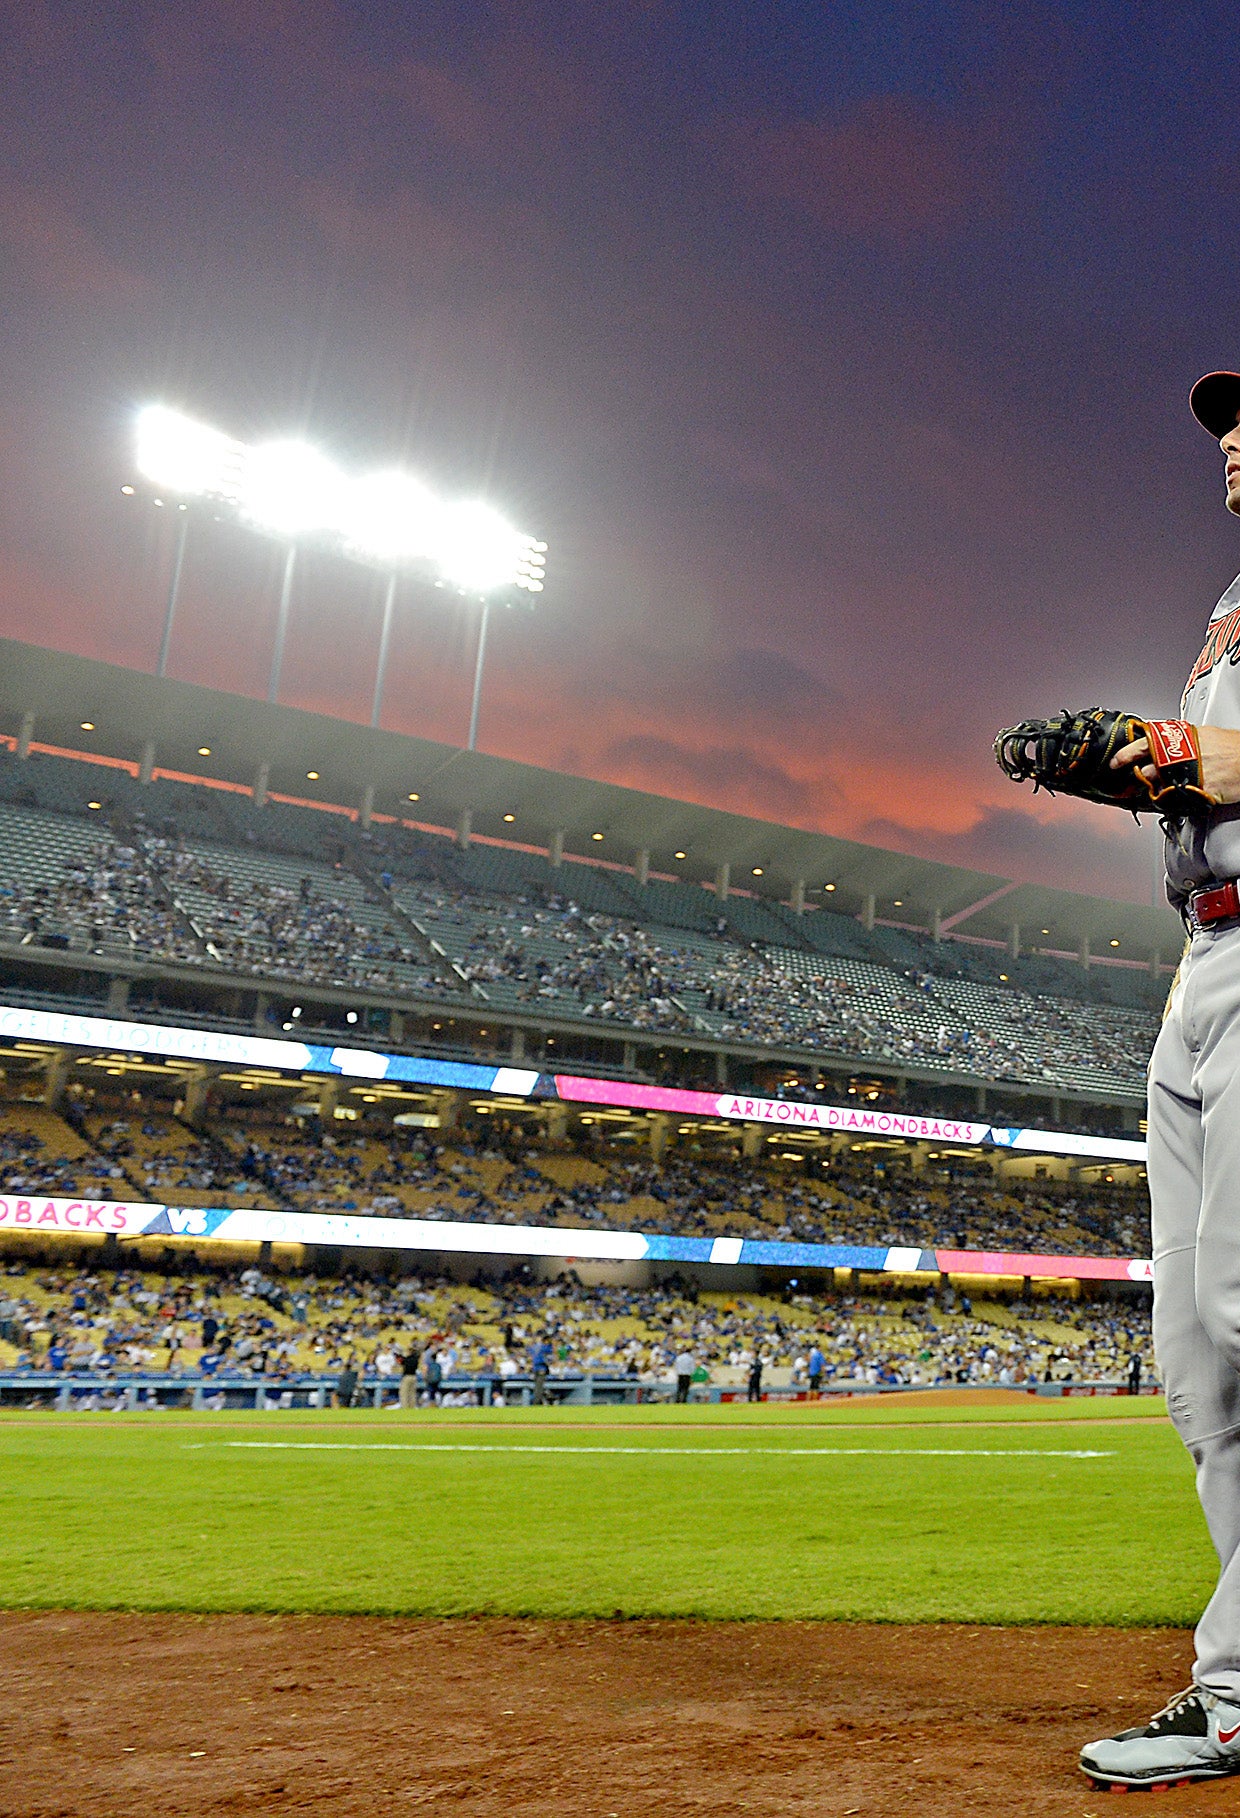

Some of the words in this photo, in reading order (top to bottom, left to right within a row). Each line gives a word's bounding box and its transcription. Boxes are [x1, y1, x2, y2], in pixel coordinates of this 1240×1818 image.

[729, 1099, 820, 1123] ARIZONA
[828, 1109, 972, 1140] DIAMONDBACKS
[166, 1208, 208, 1234] VS
